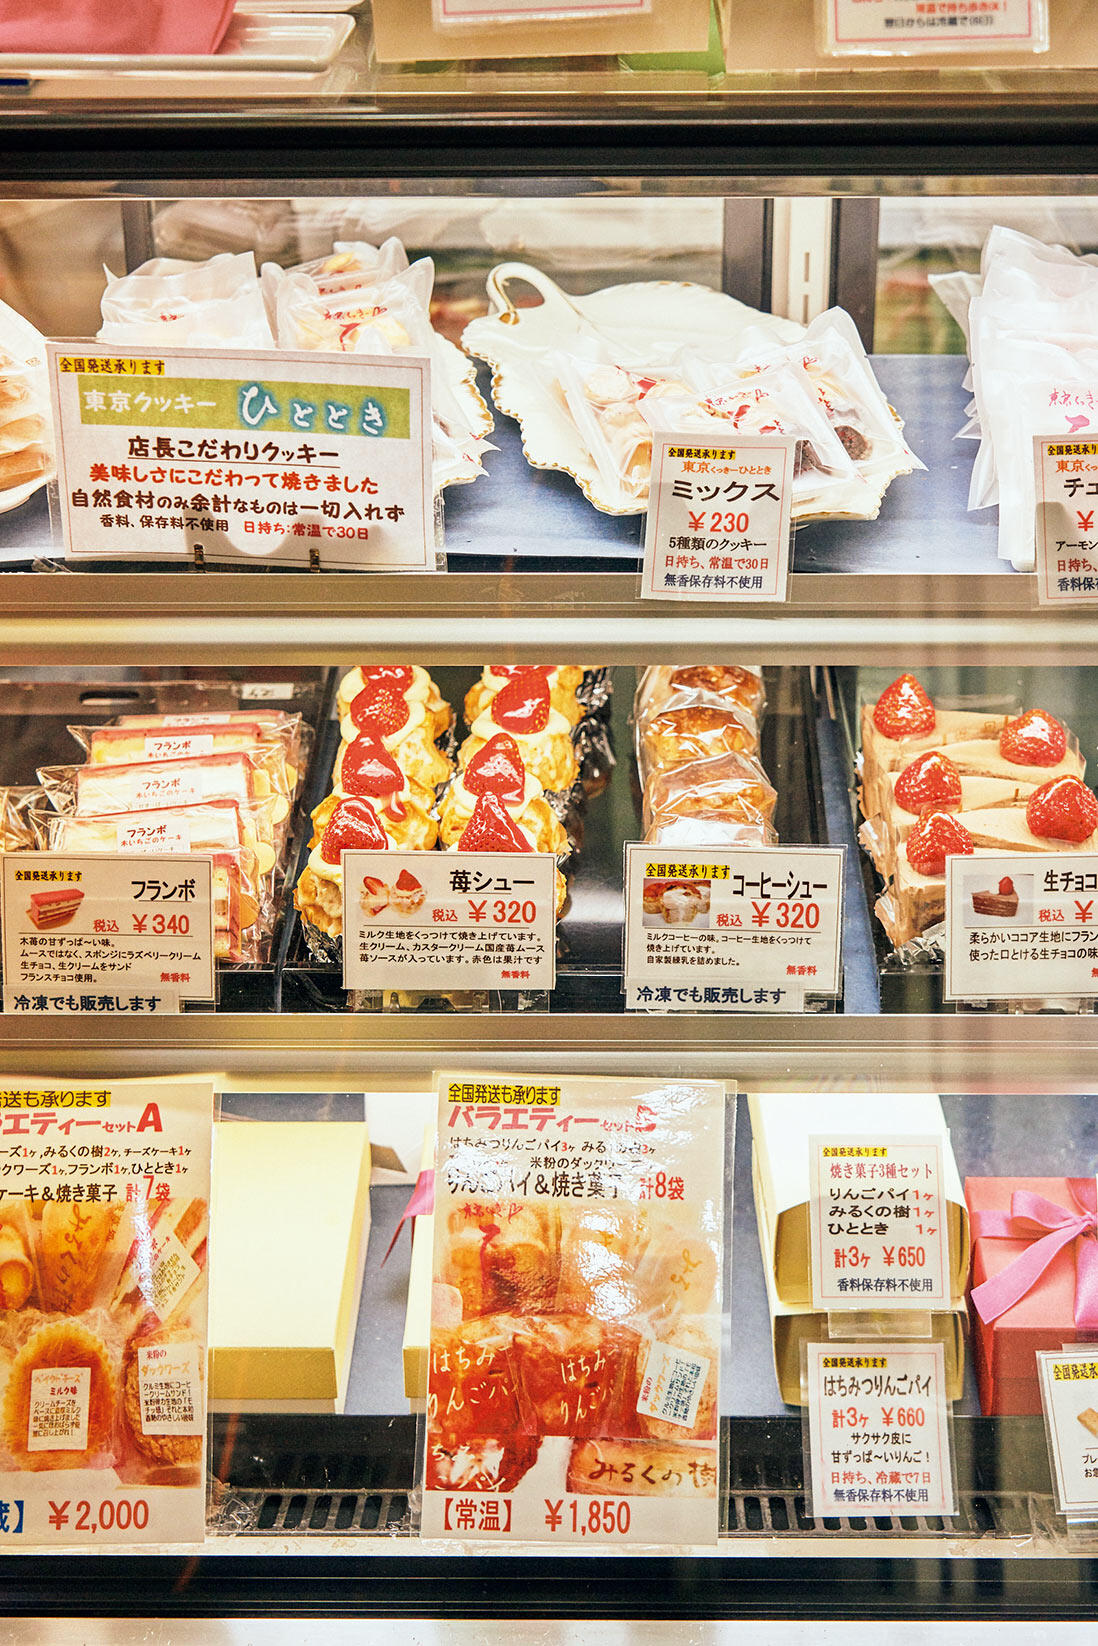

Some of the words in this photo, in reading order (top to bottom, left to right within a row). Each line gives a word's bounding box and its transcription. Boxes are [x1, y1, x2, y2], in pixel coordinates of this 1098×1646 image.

[60, 358, 165, 375] 全国発送承ります
[1048, 388, 1098, 411] 東京くっき
[83, 388, 216, 416] 東京クッキー
[240, 387, 384, 435] ひととき
[127, 435, 339, 464] 店長こだわりクッキー
[668, 447, 736, 461] 全国発送承ります
[681, 460, 772, 475] 東京くっきーひととき
[89, 462, 379, 496] 美味しさにこだわって焼きました
[671, 479, 780, 503] ミックス
[71, 488, 405, 523] 自然食材のみ余計なものは一切入れず
[99, 513, 230, 533] 香料、保存料不使用
[688, 510, 750, 533] ¥230
[669, 536, 768, 551] 5種類のクッキー
[665, 555, 769, 570] 日持ち、常温で30日
[664, 572, 763, 589] 無香保存料不使用
[142, 778, 181, 790] フランボ
[127, 825, 168, 839] フランボ
[15, 870, 82, 882] 全国発送承ります
[645, 863, 730, 880] 全国発送承ります
[449, 869, 535, 893] 苺シュー
[732, 870, 828, 900] コーヒーシュー
[1044, 869, 1098, 893] 生チョコ
[131, 878, 196, 902] フランボ
[432, 908, 458, 923] 税込
[467, 899, 537, 924] ¥320
[715, 913, 743, 928] 税込
[751, 901, 820, 929] ¥320
[1038, 908, 1065, 923] 税込
[93, 919, 120, 933] 税込
[131, 913, 190, 935] ¥340
[359, 930, 541, 942] ミルク生地をくっつけて焼き上げています。
[20, 949, 201, 961] ムースではなく、スポンジにラズベリークリーム
[359, 942, 545, 954] 生クリーム、カスタークリーム国産苺ムース
[646, 944, 716, 955] 焼き上げています。
[20, 961, 132, 971] 生チョコ、生クリームをサンド
[359, 953, 543, 965] 苺ソースが入っています。赤色は果汁です
[646, 955, 740, 966] 自家製練乳を詰めました。
[20, 973, 98, 983] フランスチョコ使用。
[160, 971, 191, 983] 無香料
[501, 970, 530, 979] 無香料
[786, 965, 818, 977] 無香料
[14, 994, 162, 1012] 冷凍でも販売します
[637, 985, 787, 1004] 冷凍でも販売します
[0, 1090, 112, 1108] 送も承ります
[448, 1083, 562, 1106] 全国発送も承ります
[0, 1103, 163, 1136] エティーセットA
[823, 1147, 888, 1158] 全国発送承ります
[830, 1163, 933, 1180] 焼き菓子3種セット
[828, 1222, 889, 1236] ひととき
[834, 1245, 871, 1269] 計3ヶ
[882, 1246, 926, 1268] ¥650
[837, 1277, 934, 1292] 香料保存料不使用
[823, 1357, 888, 1369] 全国発送承ります
[824, 1374, 932, 1397] はちみつりんごパイ
[832, 1406, 870, 1429] 計3ヶ
[881, 1406, 926, 1428] ¥660
[851, 1432, 912, 1446] サクサク皮に
[831, 1470, 931, 1485] 日持ち、冷蔵で7日
[834, 1488, 929, 1503] 無香保存料不使用
[48, 1499, 150, 1534] ¥2,000
[544, 1499, 632, 1537] ¥1,850
